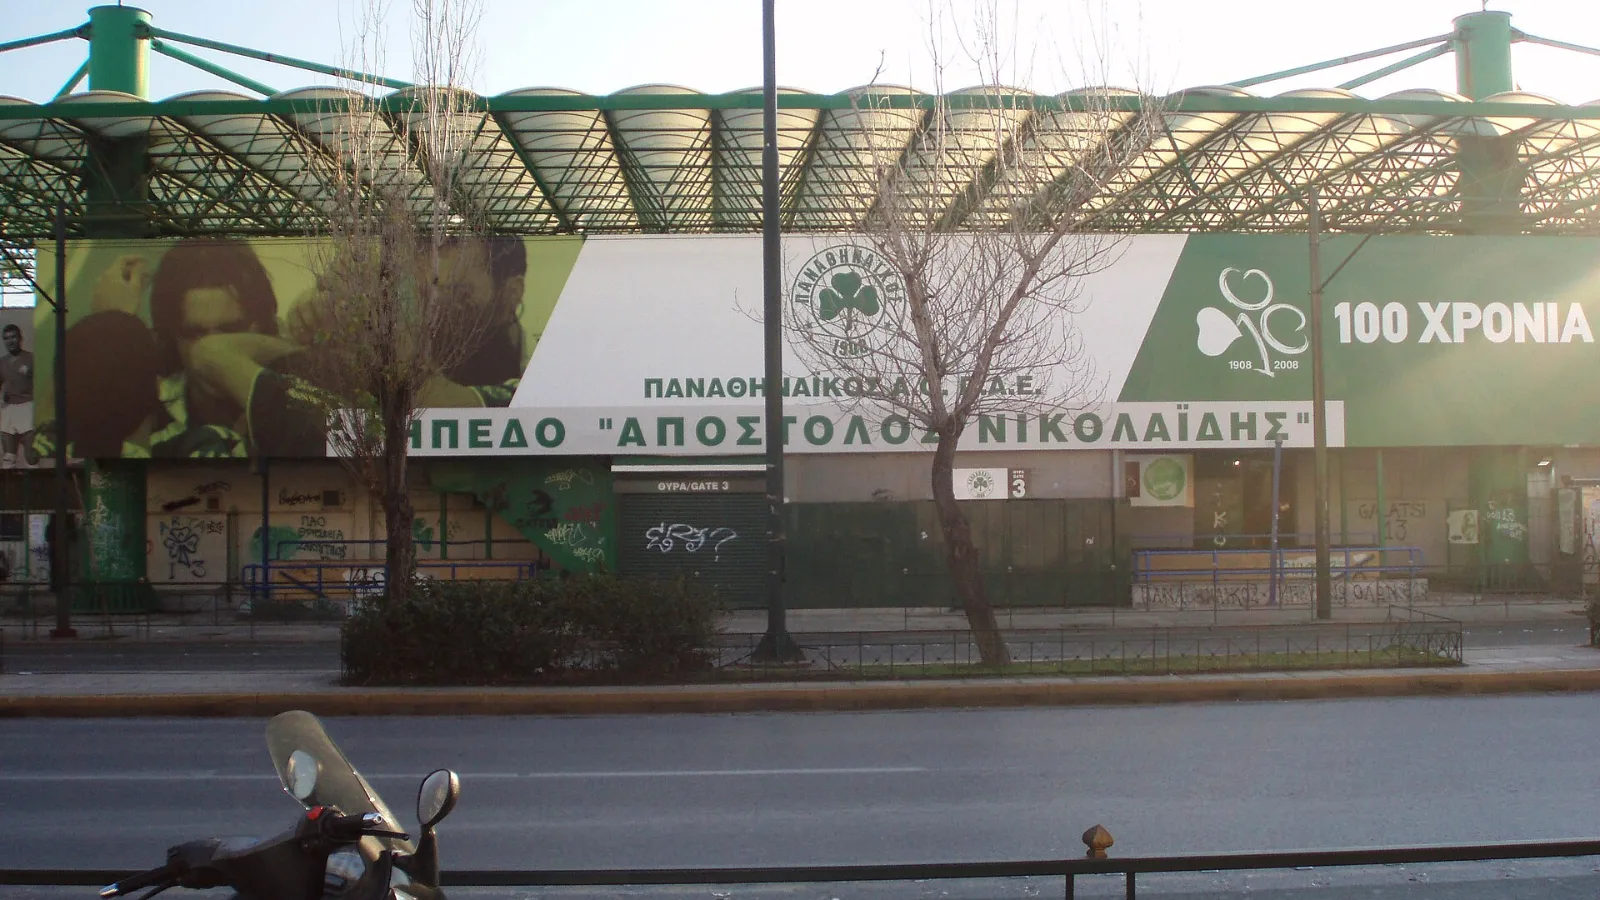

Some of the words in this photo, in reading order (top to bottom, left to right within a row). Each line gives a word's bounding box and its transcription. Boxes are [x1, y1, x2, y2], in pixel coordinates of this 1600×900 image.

[1334, 301, 1408, 344] 100
[1418, 301, 1595, 344] ΧΡΟΝΙΑ
[1228, 360, 1252, 370] 1908
[1274, 360, 1299, 370] 2008
[364, 416, 566, 448] ΠΕΔΟ
[978, 404, 1310, 443] ΝΙΚΟΛΑΪΔΗΣ"
[657, 482, 719, 491] ΘΥΡΑ/GATE
[722, 481, 729, 490] 3
[1012, 479, 1025, 498] 3
